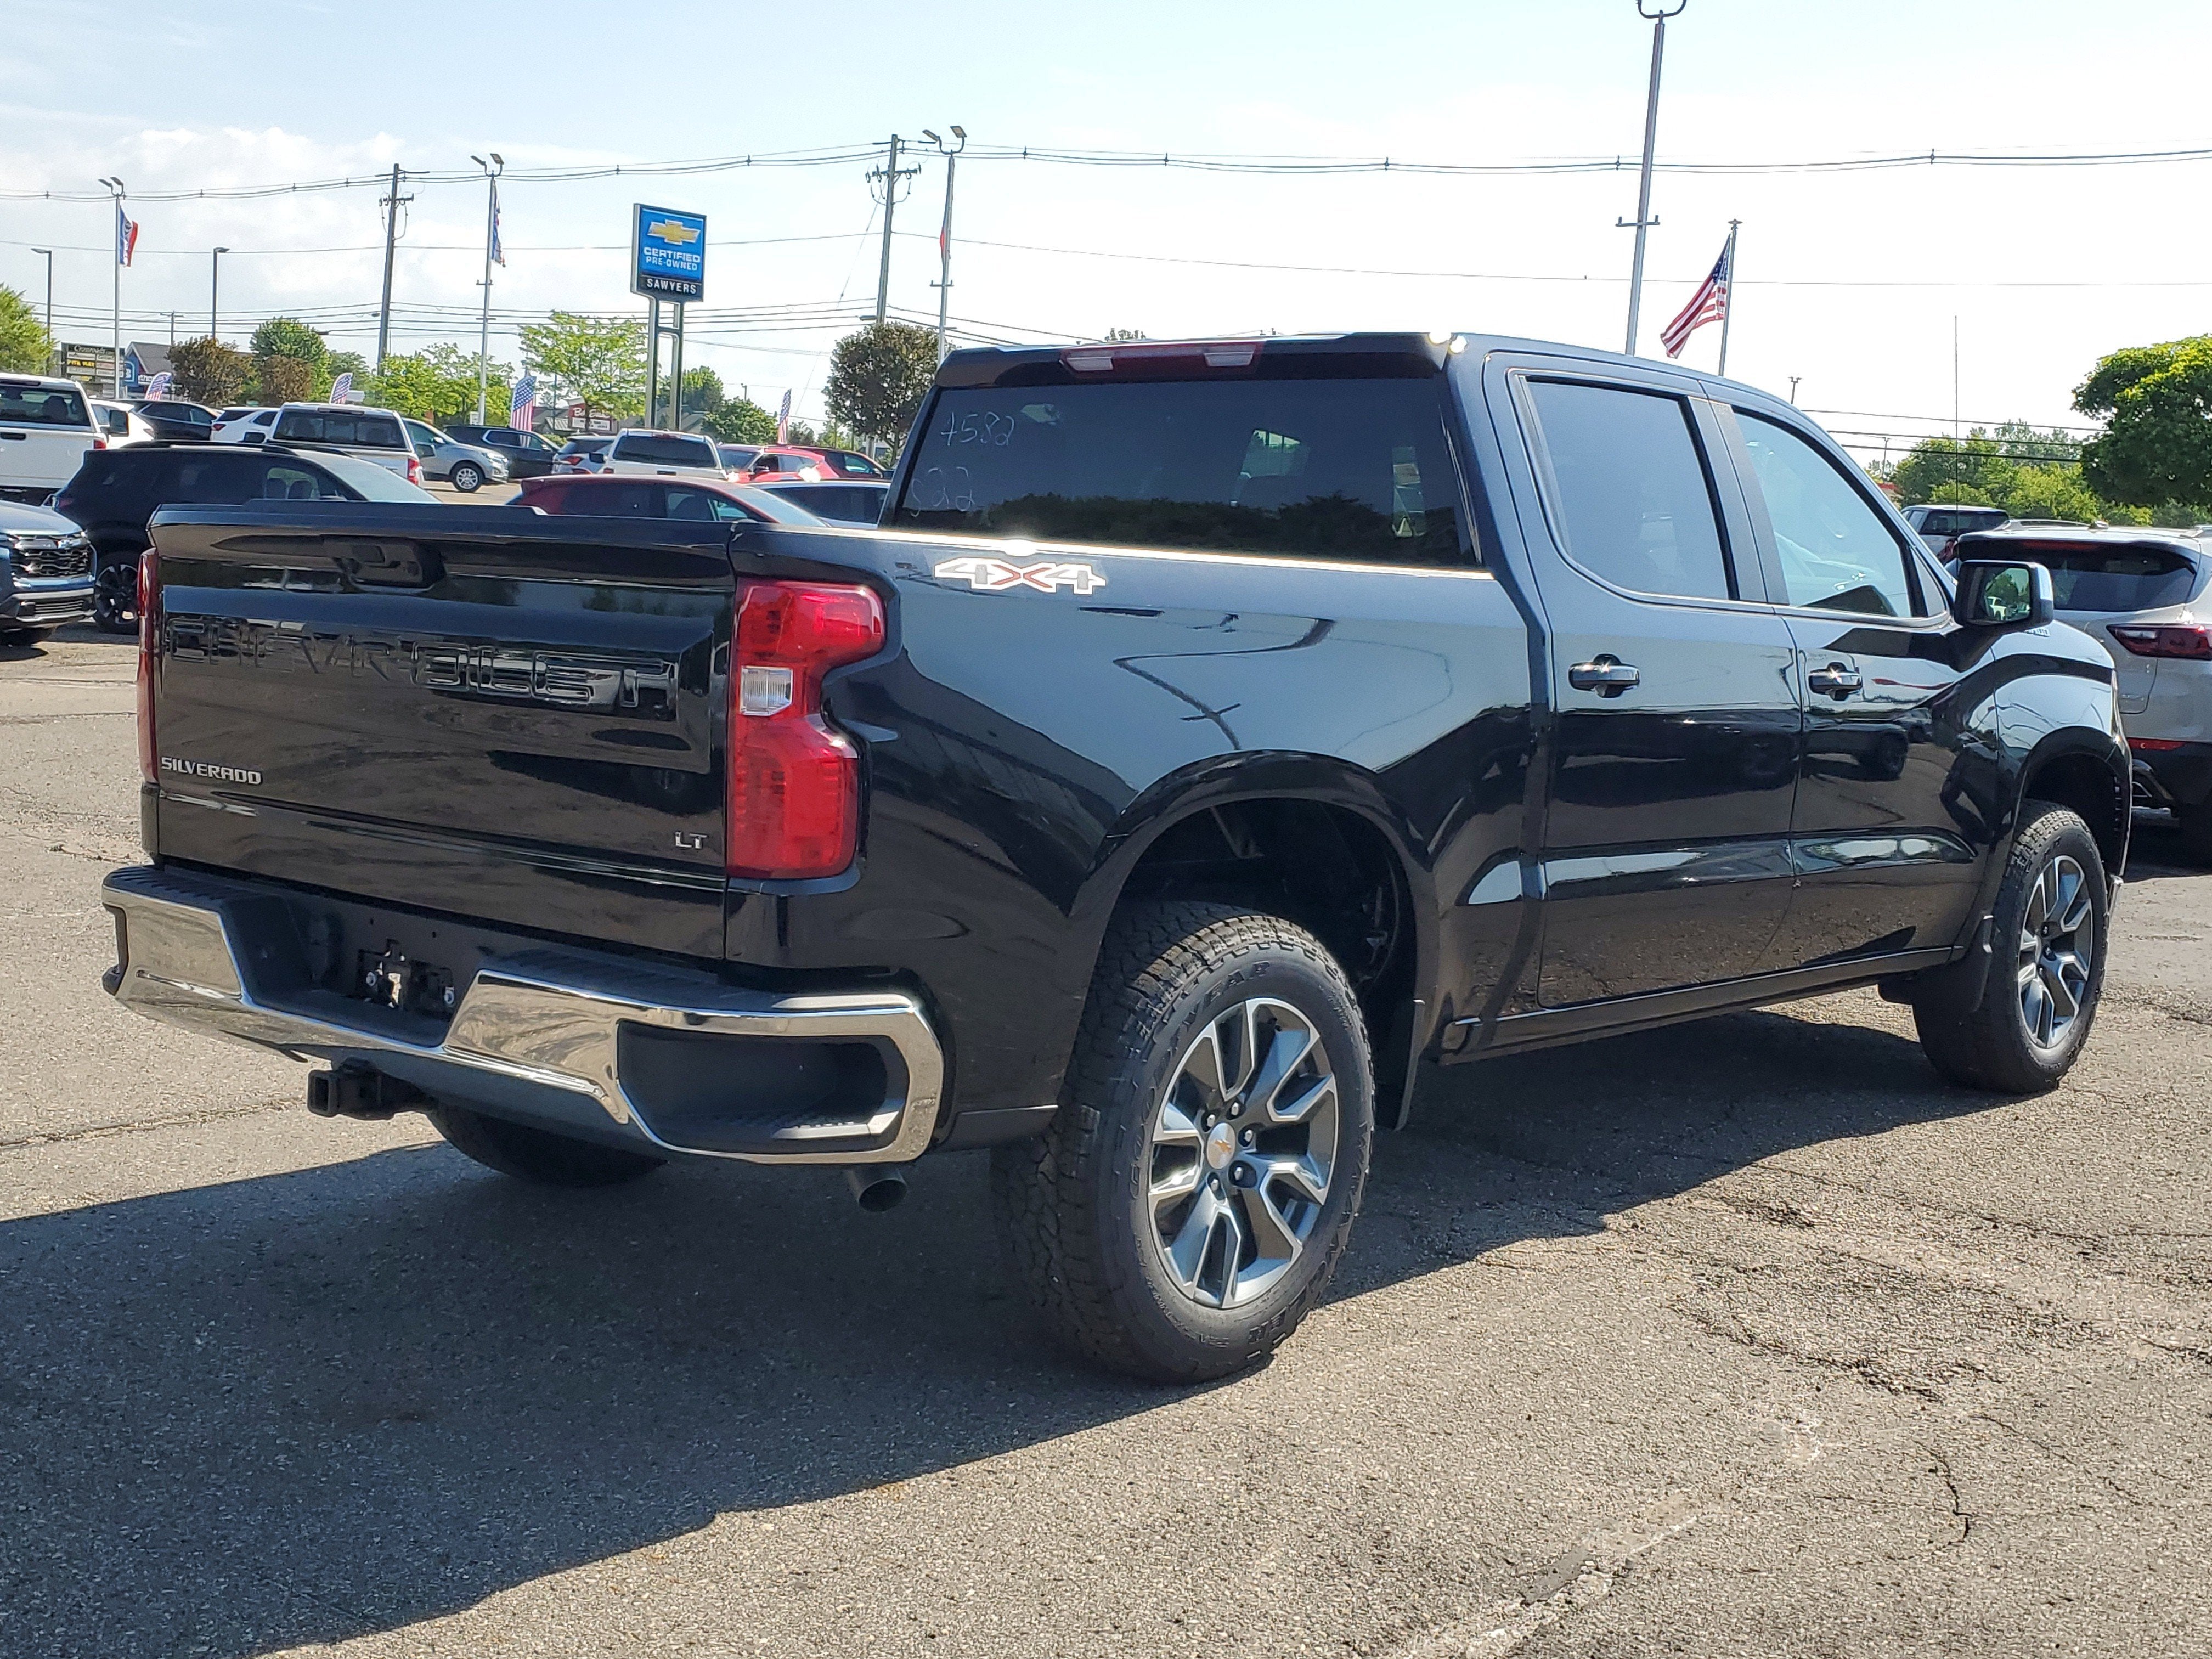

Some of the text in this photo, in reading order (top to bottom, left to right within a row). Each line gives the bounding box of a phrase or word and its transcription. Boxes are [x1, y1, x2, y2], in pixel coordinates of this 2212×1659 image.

[644, 247, 701, 263] CERTIFIED
[645, 256, 698, 271] PRE-OWNED
[647, 278, 696, 294] SAWYERS
[166, 618, 669, 709] CHEVROLET
[161, 757, 262, 785] SILVERADO
[674, 831, 708, 849] LT
